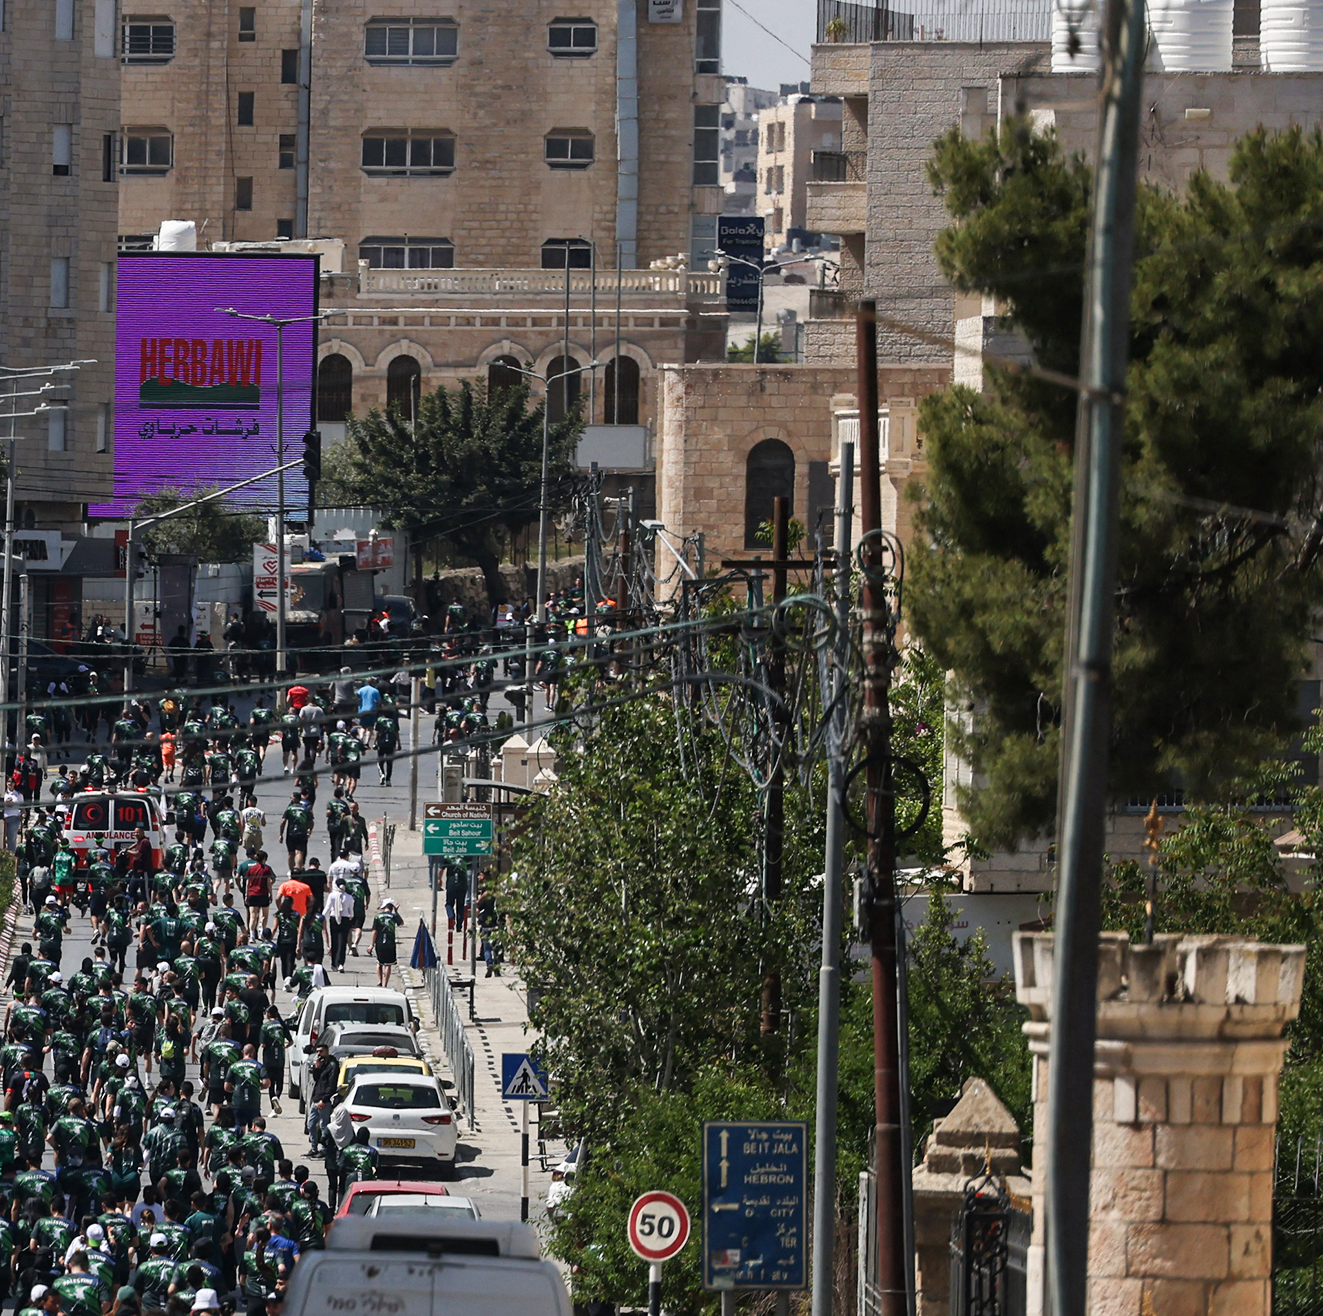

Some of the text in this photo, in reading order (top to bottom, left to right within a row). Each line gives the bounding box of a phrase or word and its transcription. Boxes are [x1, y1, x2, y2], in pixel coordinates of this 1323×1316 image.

[735, 238, 761, 246] Training
[139, 338, 262, 387] HERBAWI
[203, 417, 260, 440] فرشات
[117, 807, 144, 822] 101
[469, 811, 491, 820] Nativity
[448, 821, 469, 829] ساحور
[748, 1128, 793, 1143] بيت جالا
[743, 1142, 798, 1154] BEIT JALA
[750, 1163, 787, 1174] الخليل
[744, 1174, 794, 1185] HEBRON
[770, 1208, 795, 1217] CITY
[44, 1220, 69, 1228] PALESTINE
[639, 1213, 675, 1239] 50
[62, 1278, 95, 1286] PALESTINE
